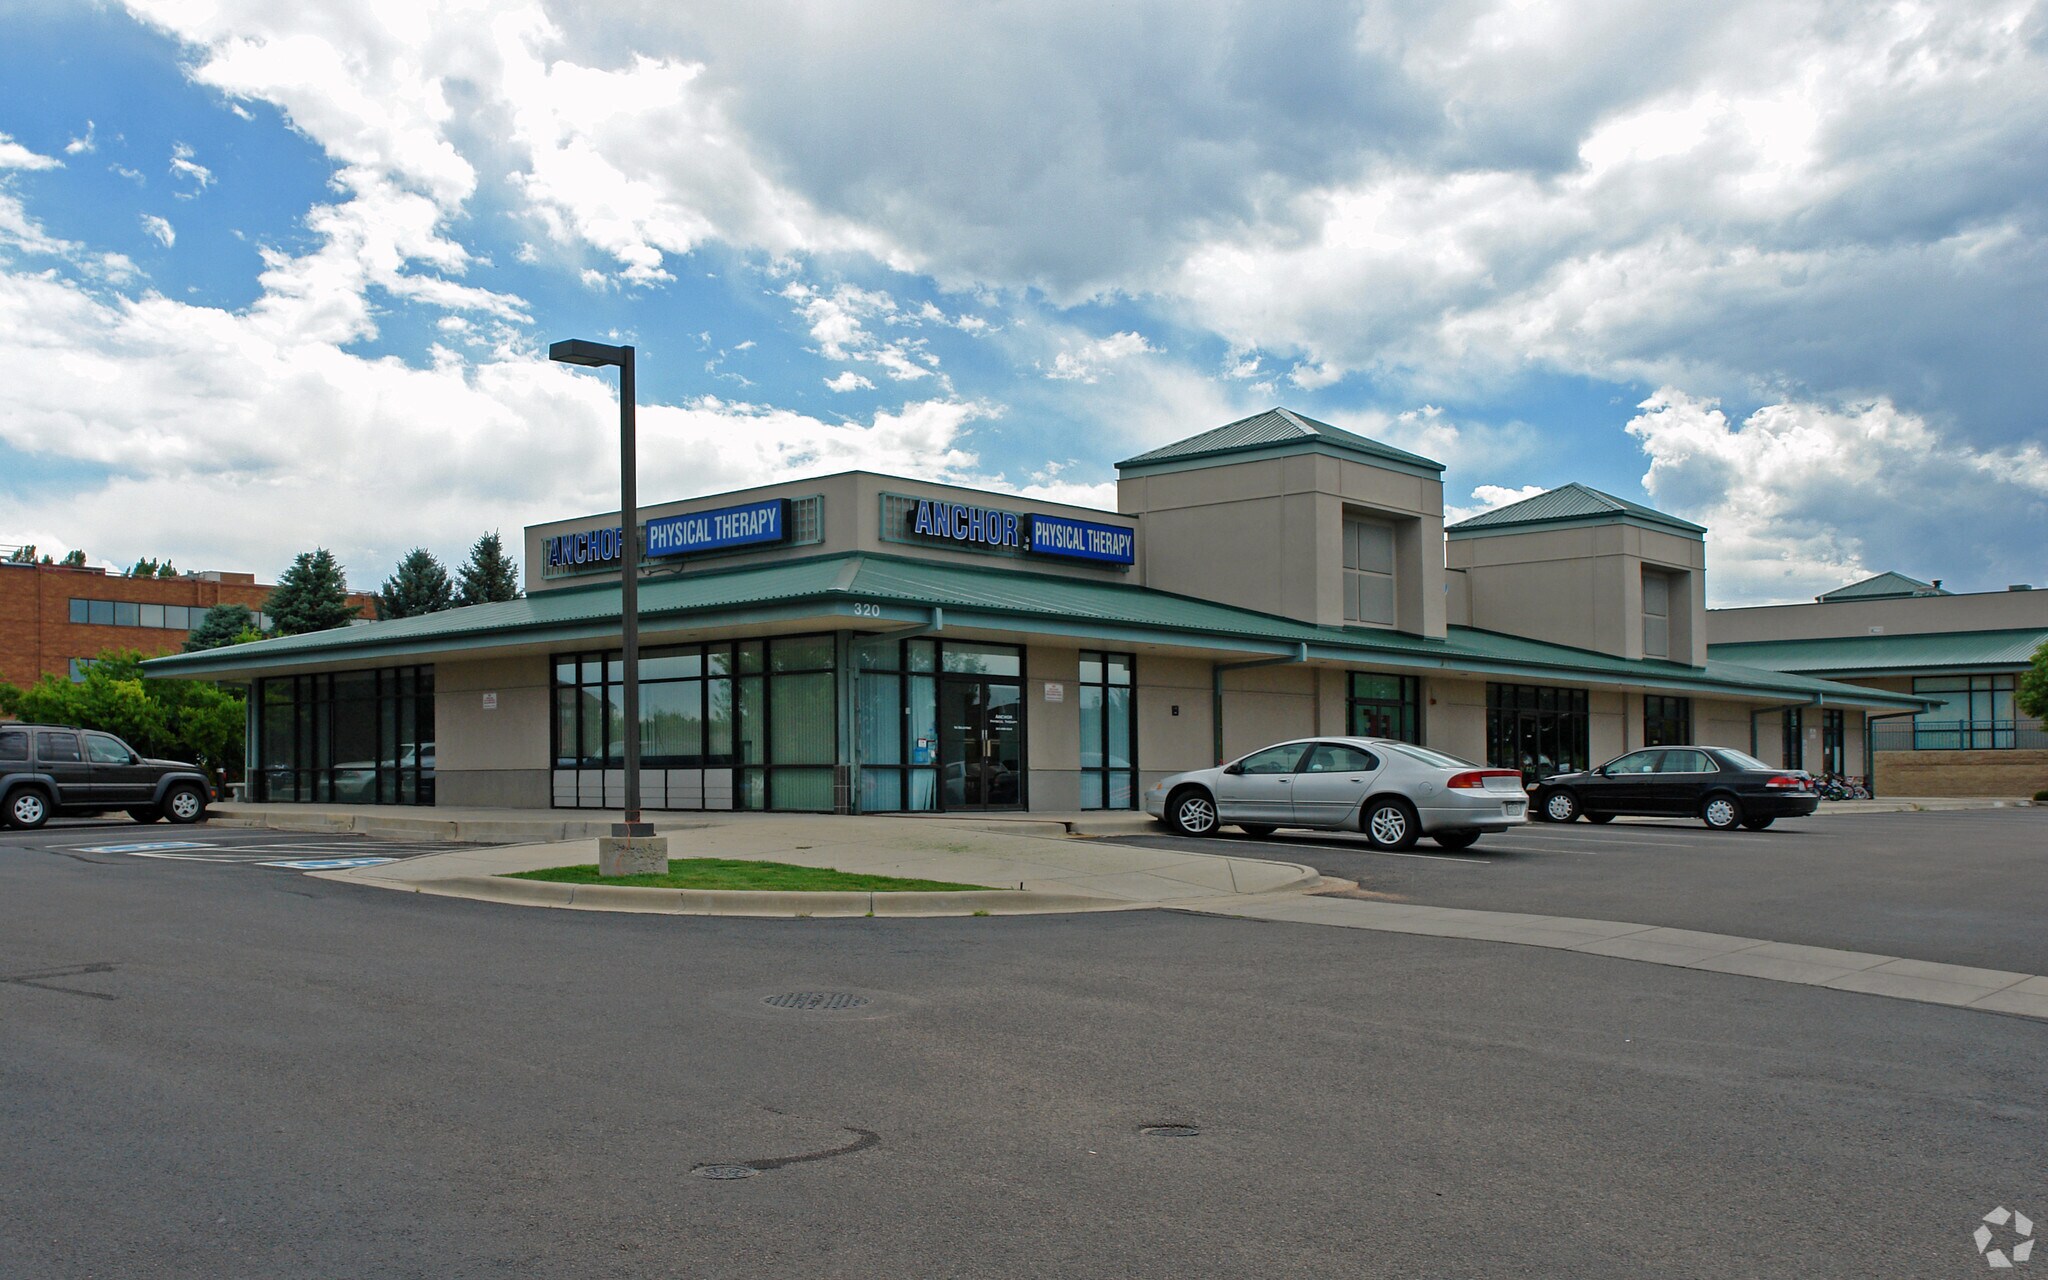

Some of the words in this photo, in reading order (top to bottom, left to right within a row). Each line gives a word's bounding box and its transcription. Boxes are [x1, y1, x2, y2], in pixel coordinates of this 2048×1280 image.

[650, 518, 712, 549] PHYSICAL
[714, 507, 776, 540] THERAPY
[915, 500, 1018, 547] ANCHOR
[1035, 521, 1085, 551] PHYSICAL
[1087, 529, 1131, 557] THERAPY
[854, 602, 880, 617] 320
